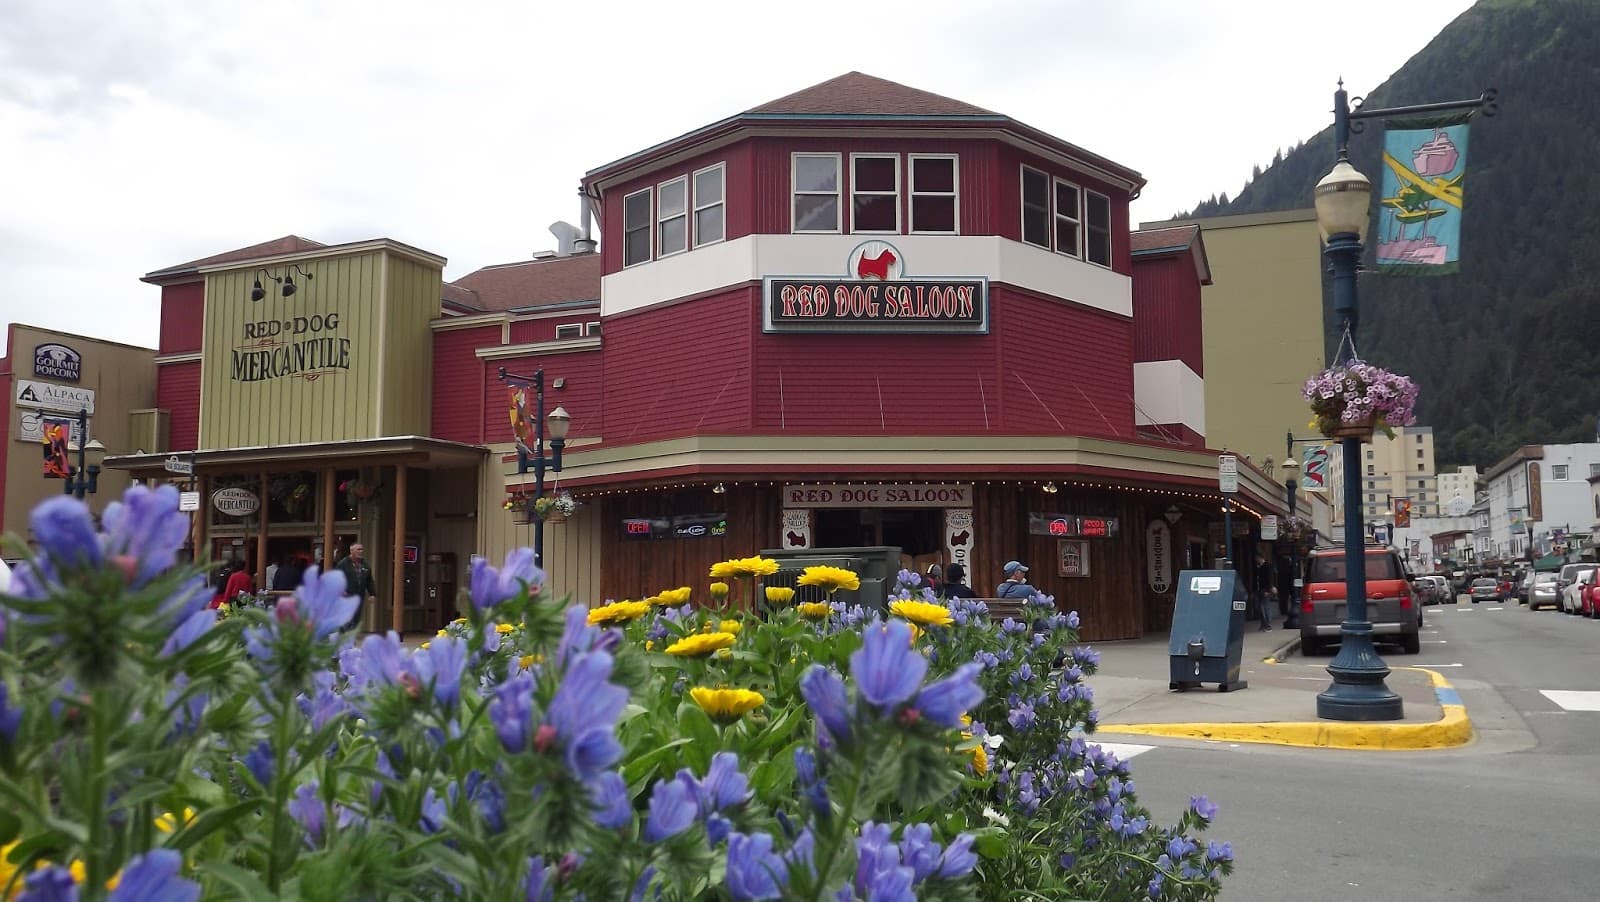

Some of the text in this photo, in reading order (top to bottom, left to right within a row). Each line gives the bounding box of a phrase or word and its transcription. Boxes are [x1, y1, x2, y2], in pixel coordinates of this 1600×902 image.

[781, 285, 974, 318] RED DOG SALOON
[245, 313, 339, 339] RED DOG
[36, 356, 79, 370] GOURMET
[232, 338, 350, 381] MERCANTILE
[36, 365, 79, 379] POPCORN
[43, 385, 91, 402] ALPACA
[790, 489, 966, 503] RED DOG SALOON
[628, 521, 649, 533] OPEN
[1050, 521, 1067, 534] OPEN
